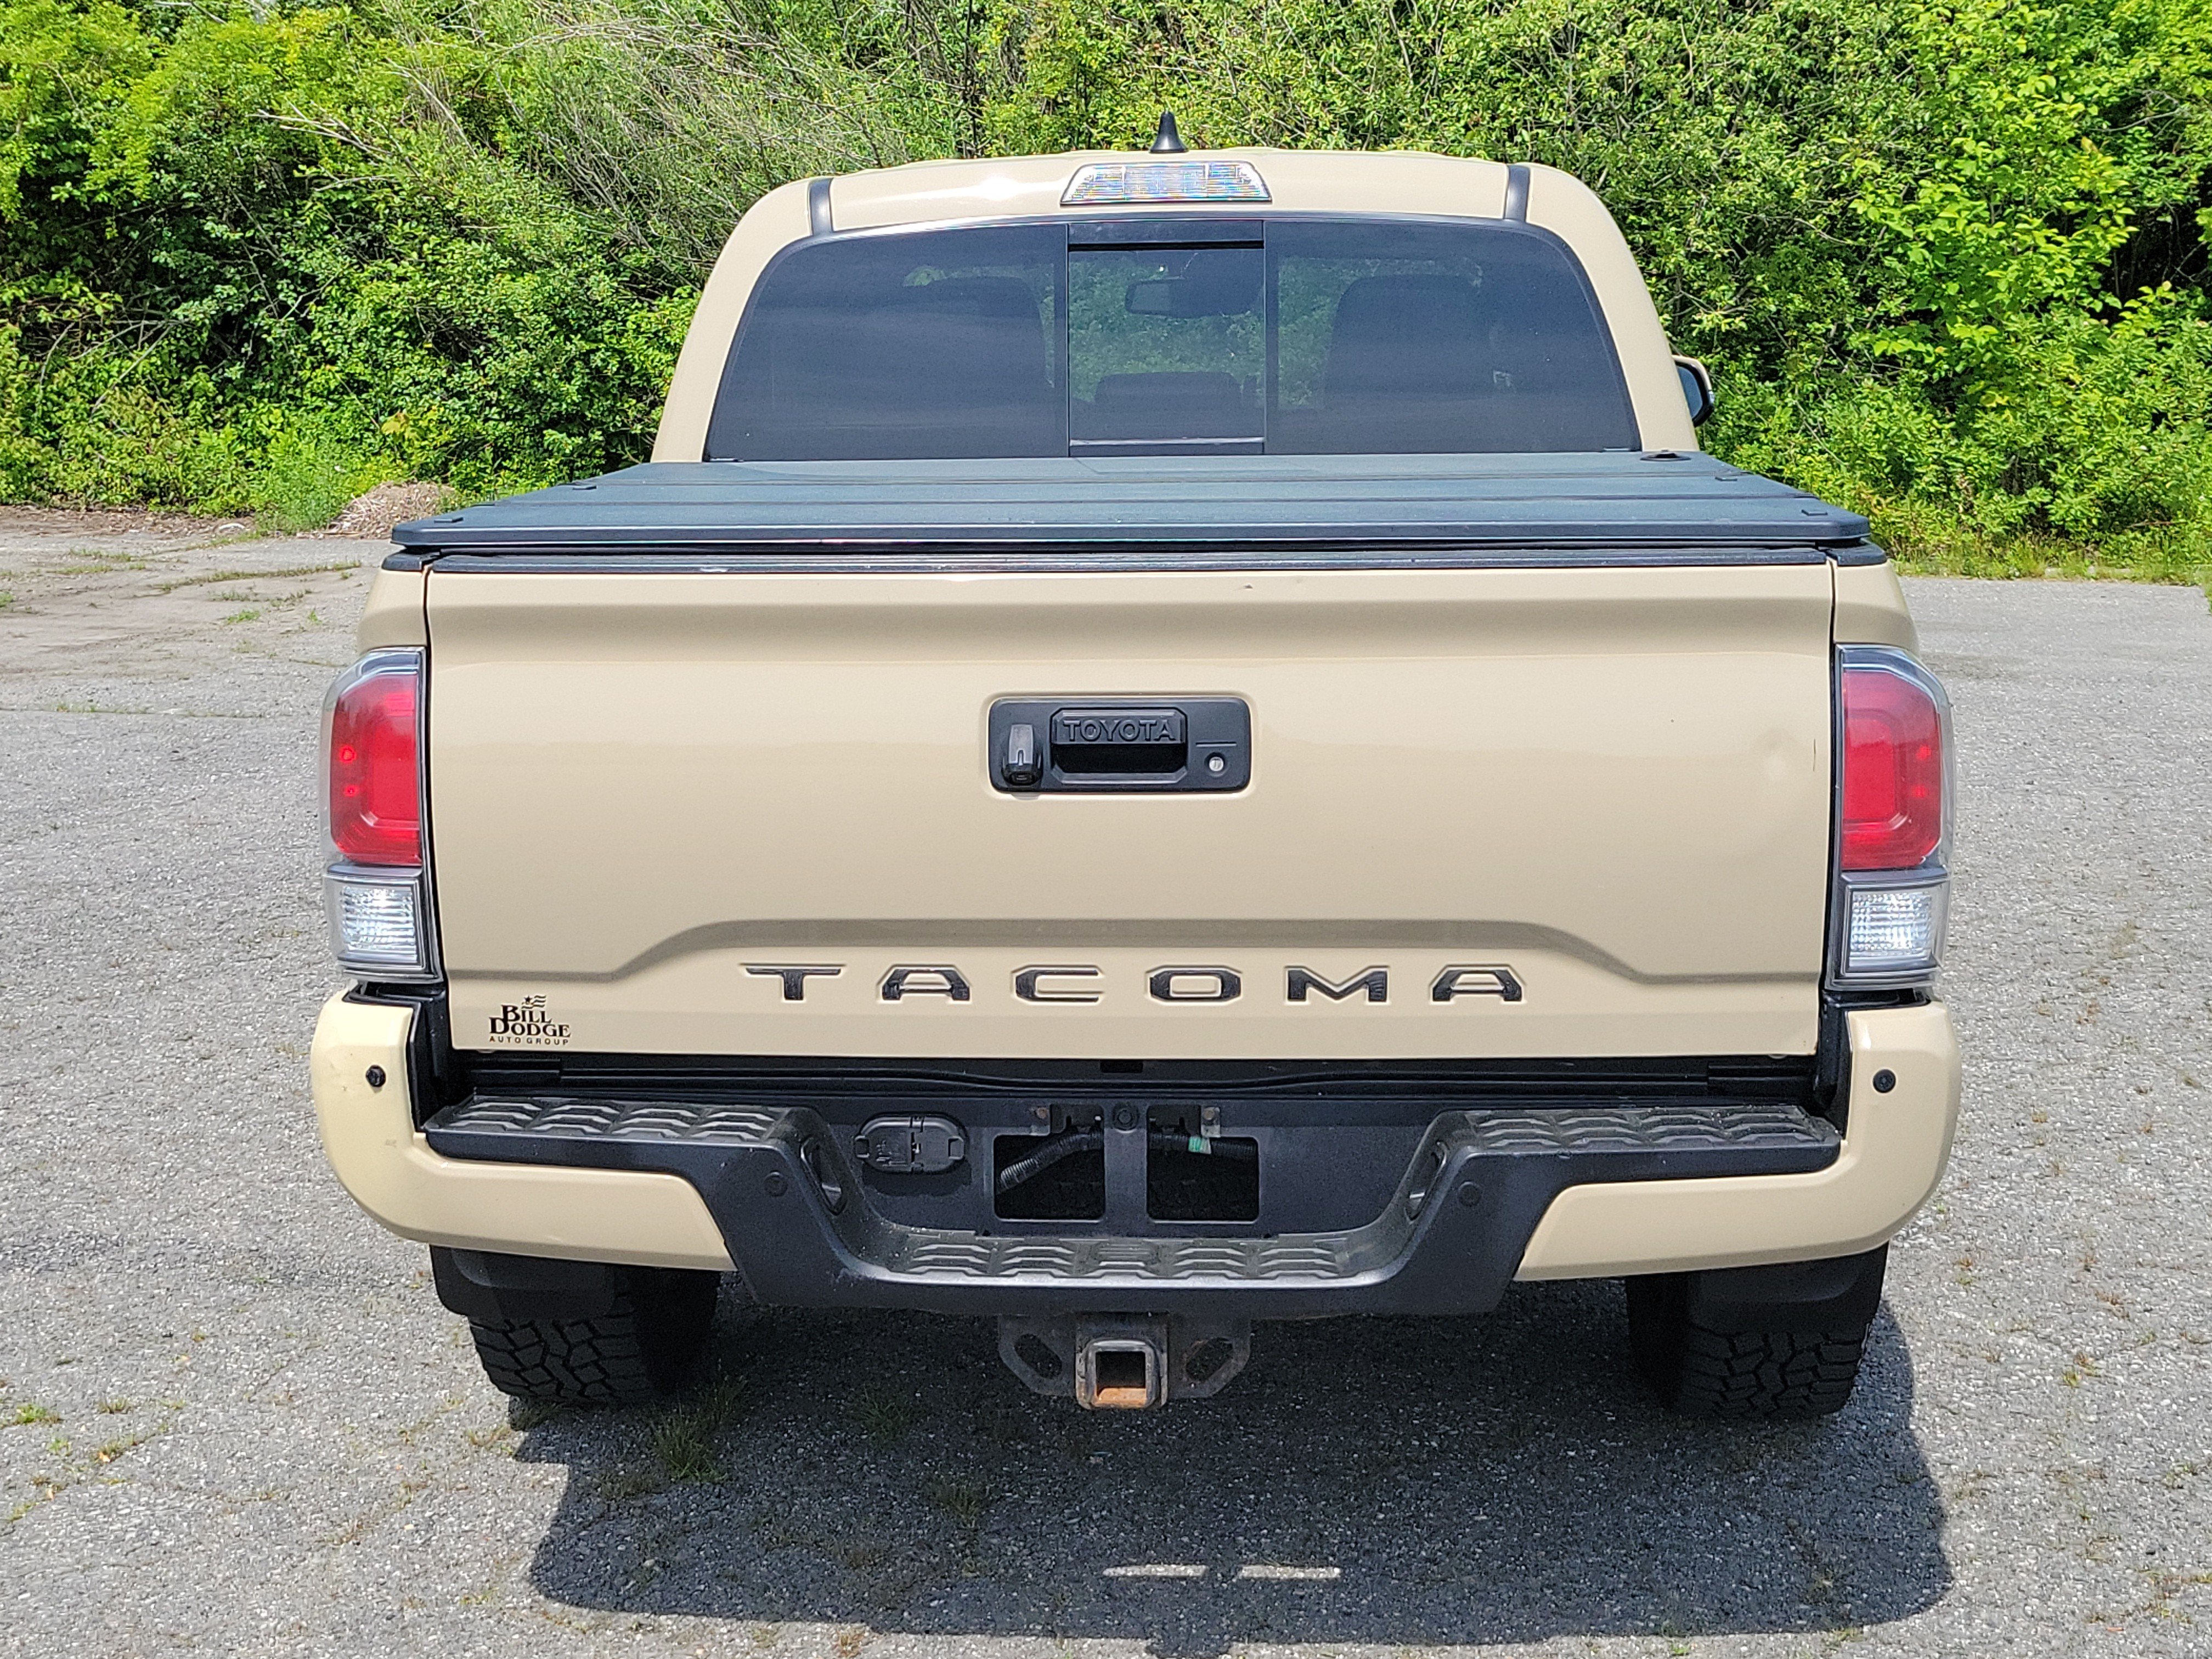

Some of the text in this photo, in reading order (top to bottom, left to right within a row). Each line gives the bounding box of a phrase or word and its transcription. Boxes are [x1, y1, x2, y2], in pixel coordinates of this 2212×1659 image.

[1063, 719, 1176, 742] TOYOTA
[742, 964, 1525, 1002] TACOMA
[501, 1005, 552, 1023] BILL
[489, 1017, 571, 1037] DODGE
[526, 1037, 569, 1045] GROUP
